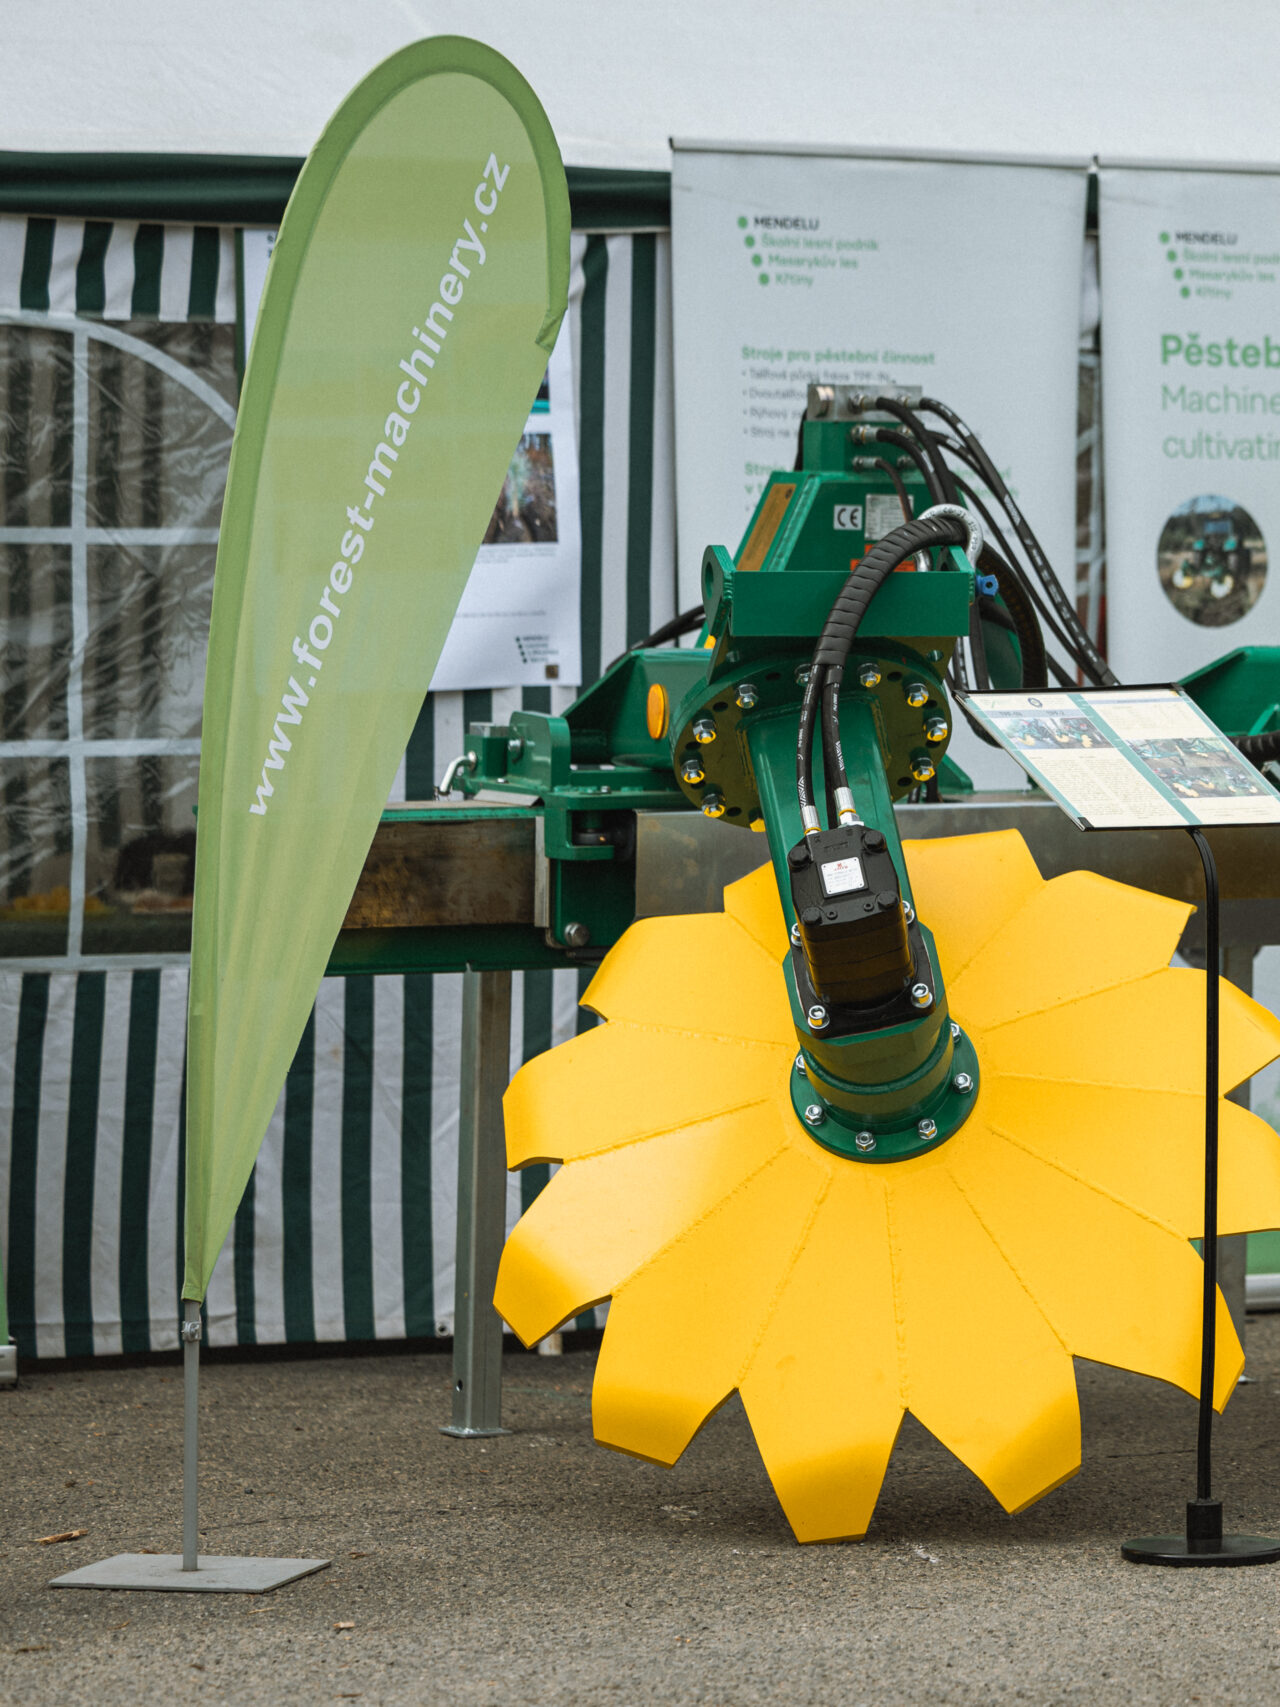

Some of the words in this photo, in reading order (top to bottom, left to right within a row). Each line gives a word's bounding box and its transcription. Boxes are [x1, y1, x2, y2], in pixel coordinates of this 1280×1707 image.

[753, 217, 819, 230] MENDELU
[1175, 232, 1238, 245] MENDELU
[741, 346, 783, 363] Stroje
[787, 350, 811, 364] pro
[248, 152, 511, 817] www.forest-machinery.cz
[837, 508, 859, 528] CE
